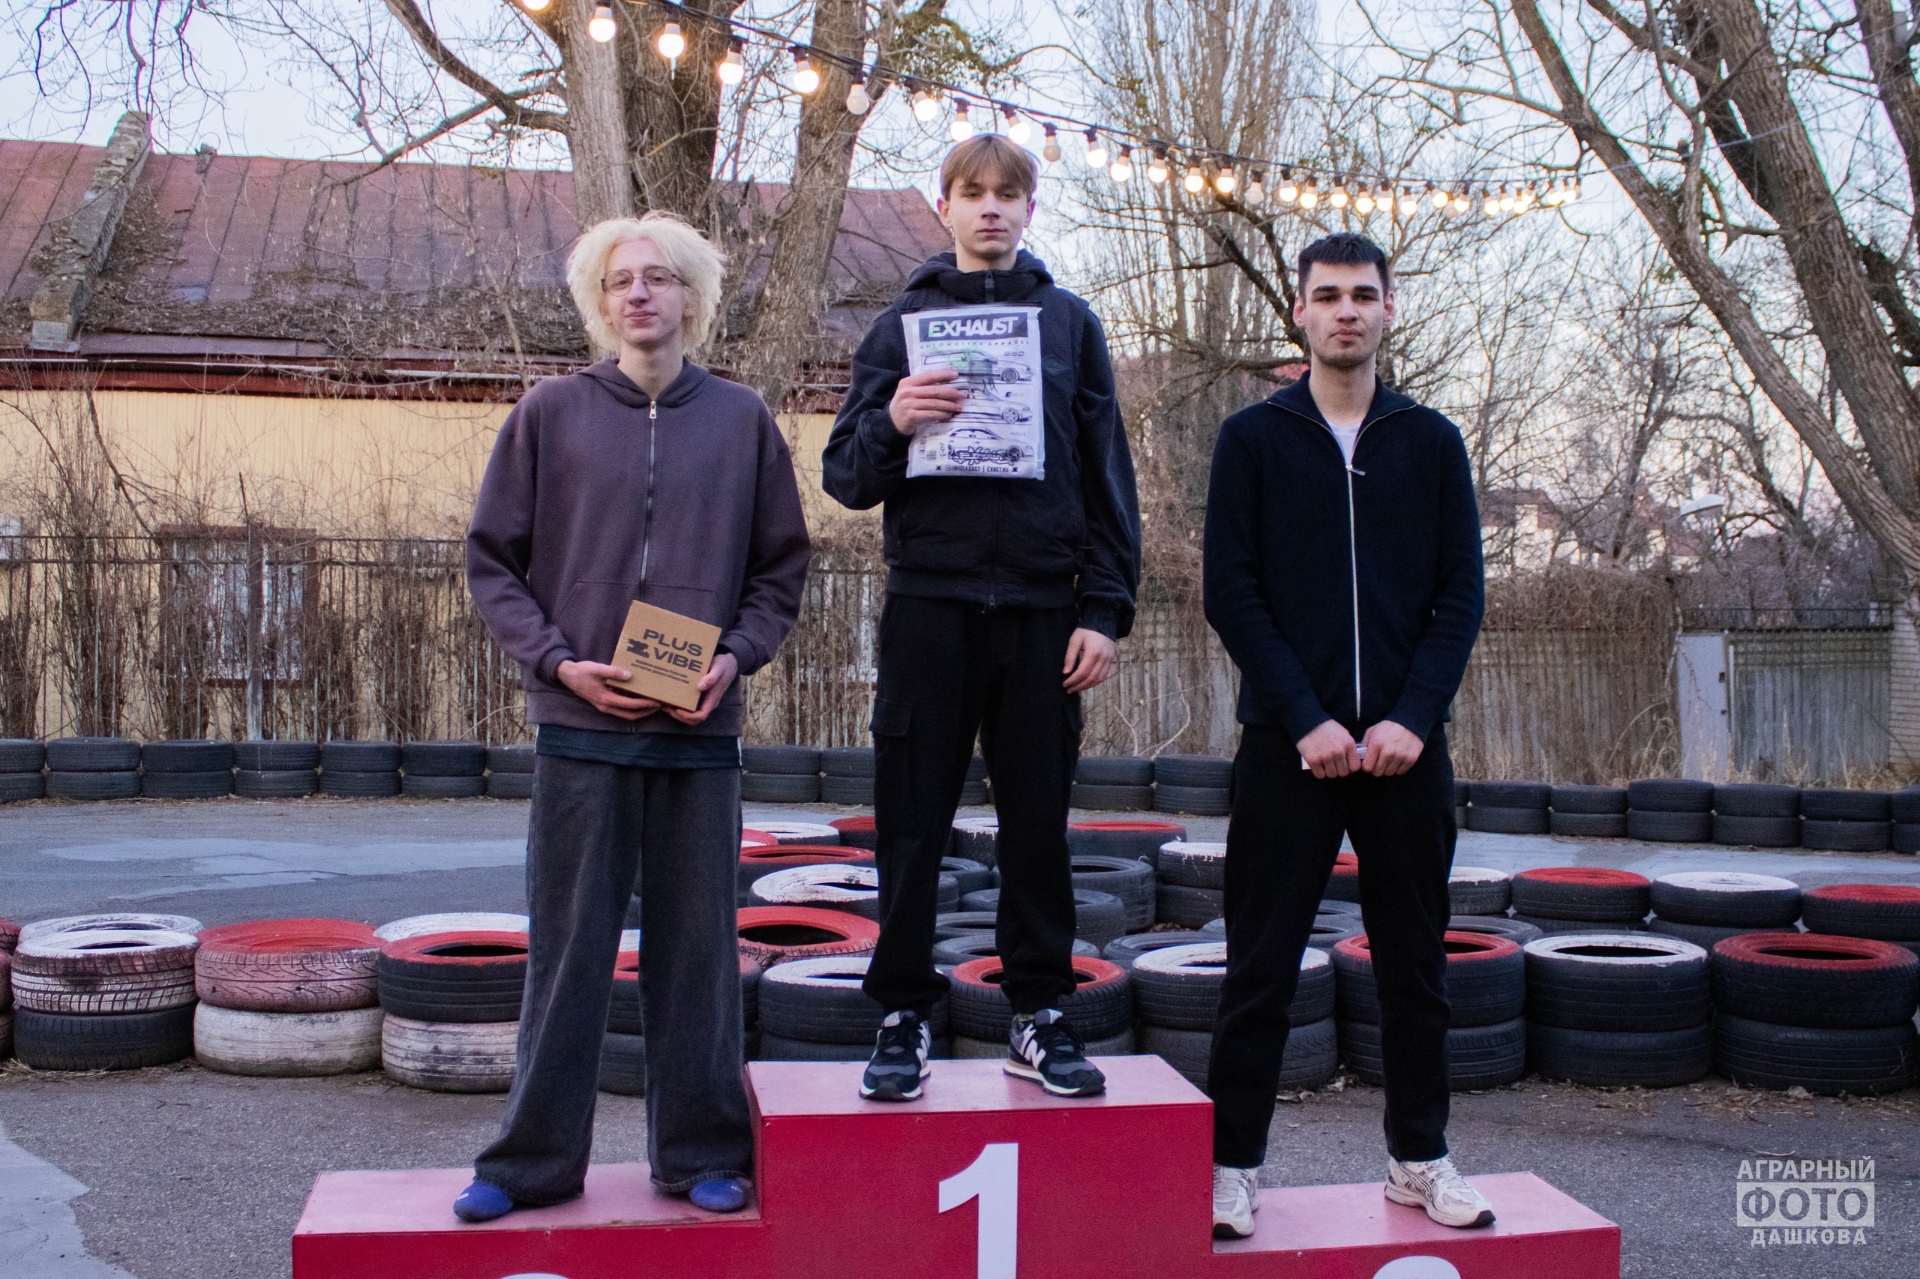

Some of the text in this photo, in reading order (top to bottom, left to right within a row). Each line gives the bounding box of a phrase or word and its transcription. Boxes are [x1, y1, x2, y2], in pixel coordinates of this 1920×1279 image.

[928, 316, 1018, 338] EXHAUST
[643, 628, 703, 657] PLUS
[651, 647, 703, 673] VIBE
[937, 1143, 1019, 1279] 1
